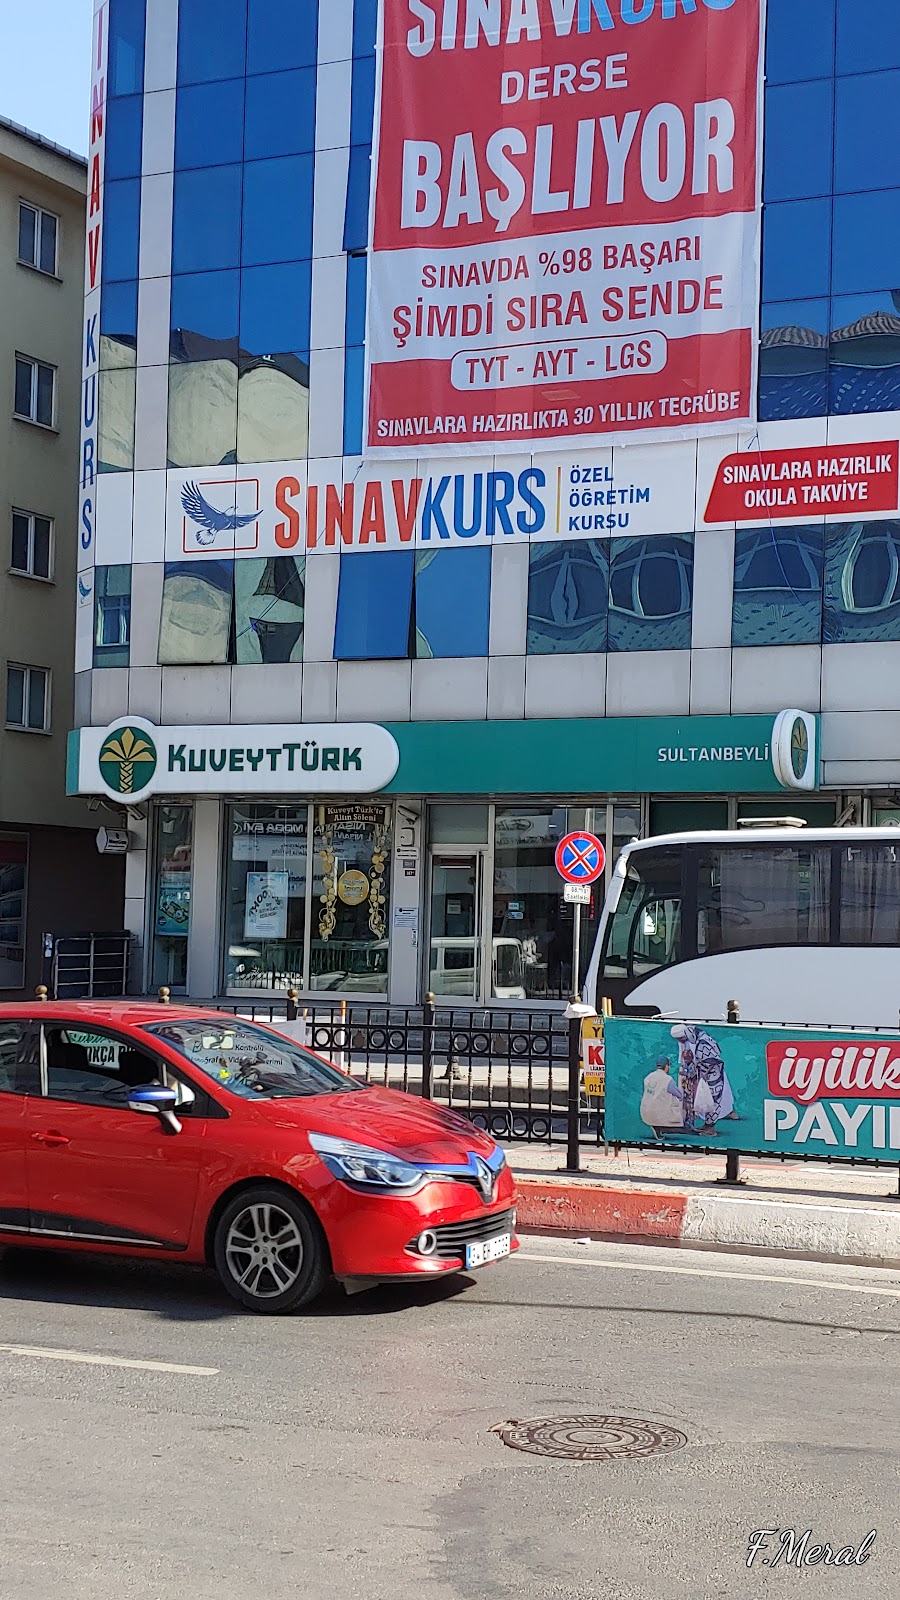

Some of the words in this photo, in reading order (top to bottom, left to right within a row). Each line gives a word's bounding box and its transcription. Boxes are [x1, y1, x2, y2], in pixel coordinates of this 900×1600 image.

[500, 53, 628, 105] DERSE
[400, 98, 736, 233] BAŞLIYOR
[422, 255, 530, 289] SINAVDA
[538, 248, 593, 276] %98
[602, 235, 702, 273] BAŞARI
[393, 294, 493, 348] ŞİMDİ
[506, 291, 589, 332] SIRA
[602, 275, 724, 323] SENDE
[466, 355, 509, 384] TYT
[532, 348, 579, 378] AYT
[605, 340, 652, 372] LGS
[81, 313, 98, 550] KURS
[377, 414, 468, 438] SINAVLARA
[472, 408, 569, 433] HAZIRLIKTA
[573, 406, 594, 425] 30
[598, 400, 653, 423] YILLIK
[658, 390, 741, 417] TECRÜBE
[569, 466, 614, 484] ÖZEL
[723, 463, 813, 485] SINAVLARA
[816, 454, 893, 478] HAZIRLIK
[274, 467, 546, 549] SINAVKURS
[569, 485, 650, 507] ÖĞRETİM
[744, 488, 797, 508] OKULA
[801, 481, 868, 502] TAKVİYE
[568, 512, 629, 531] KURSU
[657, 743, 769, 762] SULTANBEYLİ
[327, 807, 354, 815] Kuveyt
